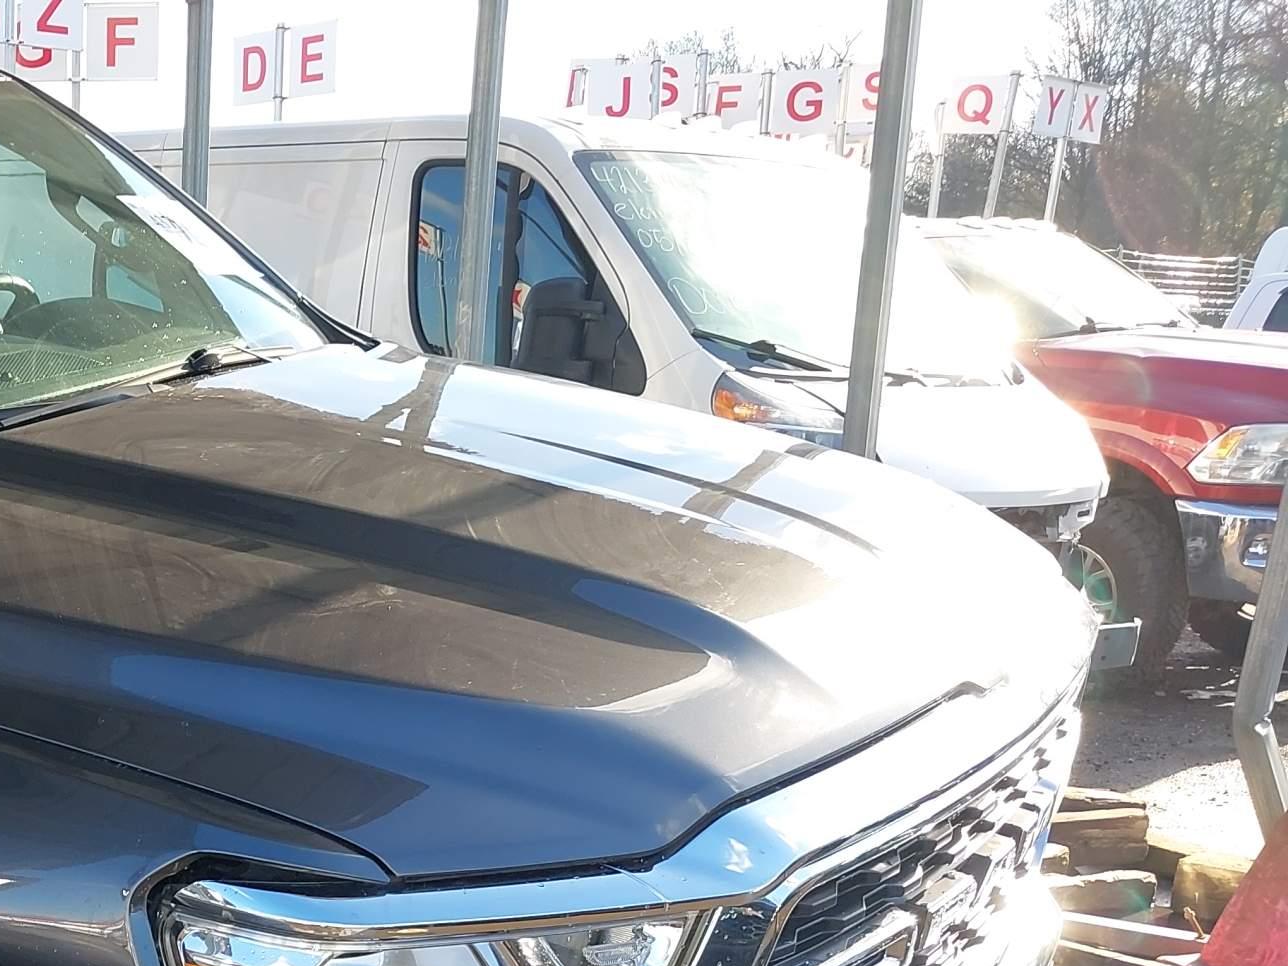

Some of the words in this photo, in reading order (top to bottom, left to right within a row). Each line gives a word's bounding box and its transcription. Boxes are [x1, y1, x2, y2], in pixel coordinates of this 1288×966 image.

[37, 0, 69, 35] Z
[106, 17, 138, 67] F
[301, 34, 324, 84] E
[242, 46, 267, 92] D
[605, 76, 631, 118] J
[786, 81, 823, 122] G
[956, 83, 993, 126] Q
[1046, 87, 1066, 126] Y
[1077, 93, 1100, 133] X
